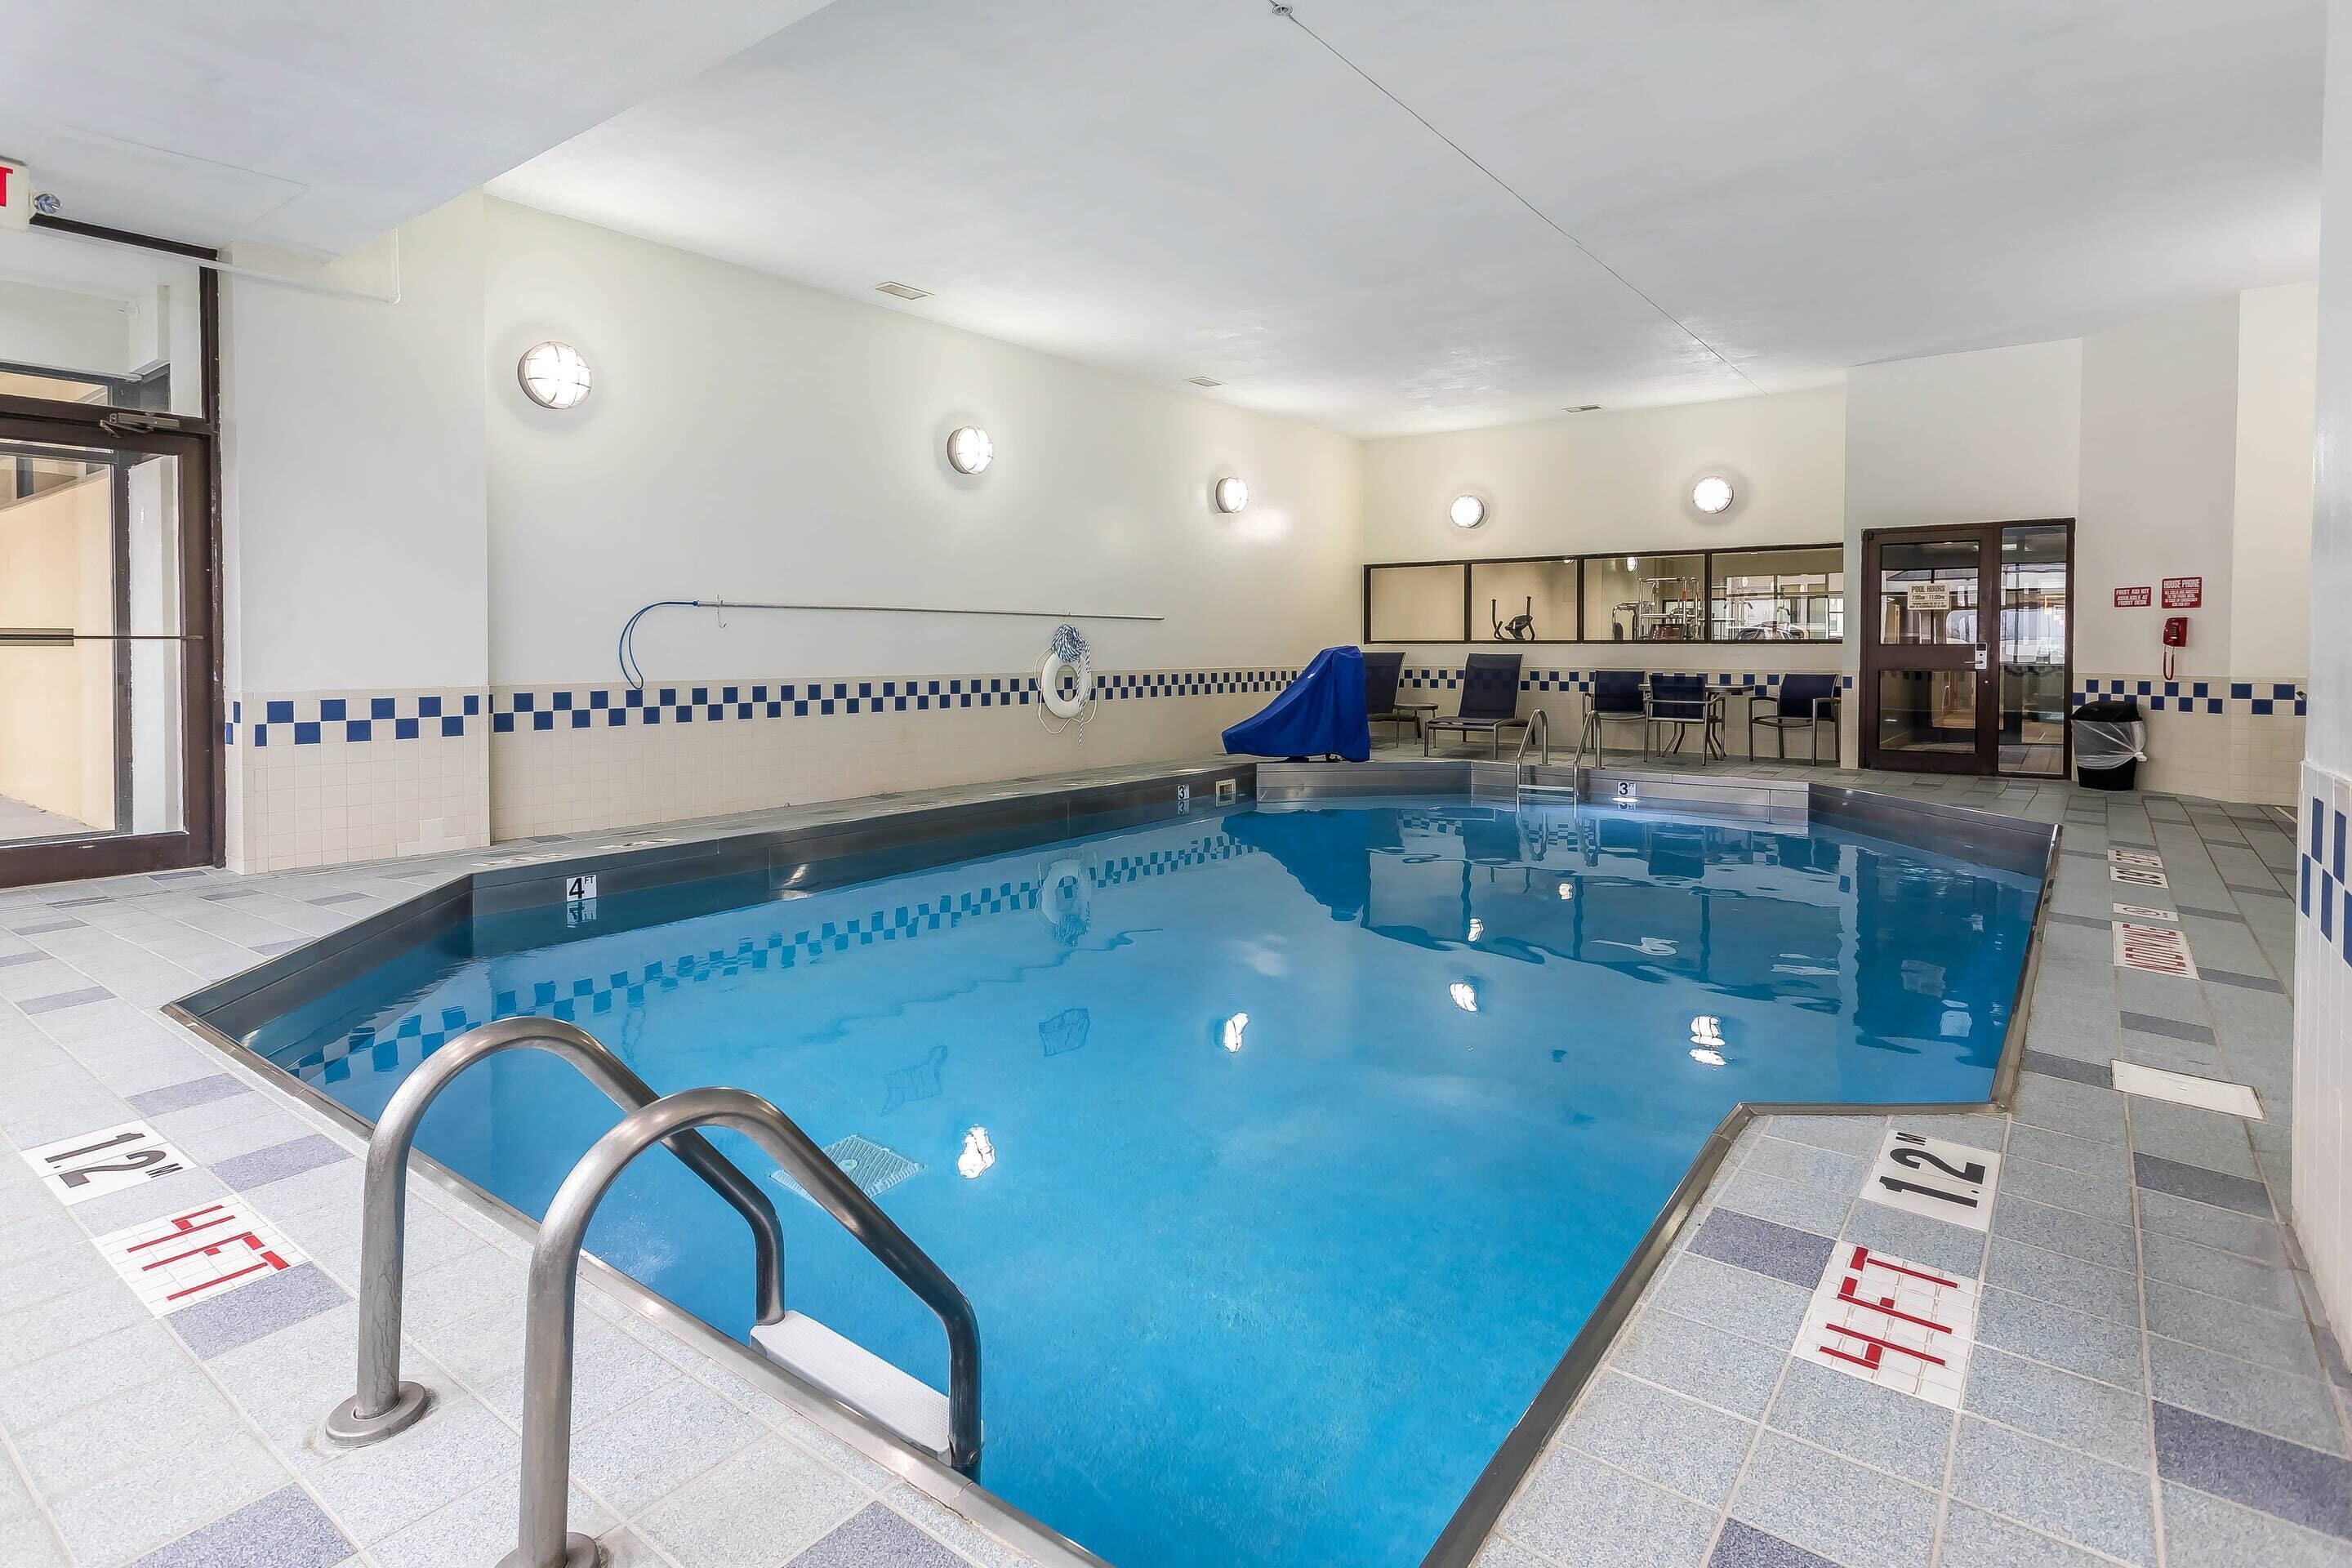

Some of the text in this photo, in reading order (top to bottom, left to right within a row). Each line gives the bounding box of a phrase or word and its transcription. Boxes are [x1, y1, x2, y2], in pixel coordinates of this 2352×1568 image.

[2164, 579, 2200, 588] HOUSE PHONE
[127, 1204, 291, 1301] 4FT
[1818, 1246, 1959, 1370] 4FT
